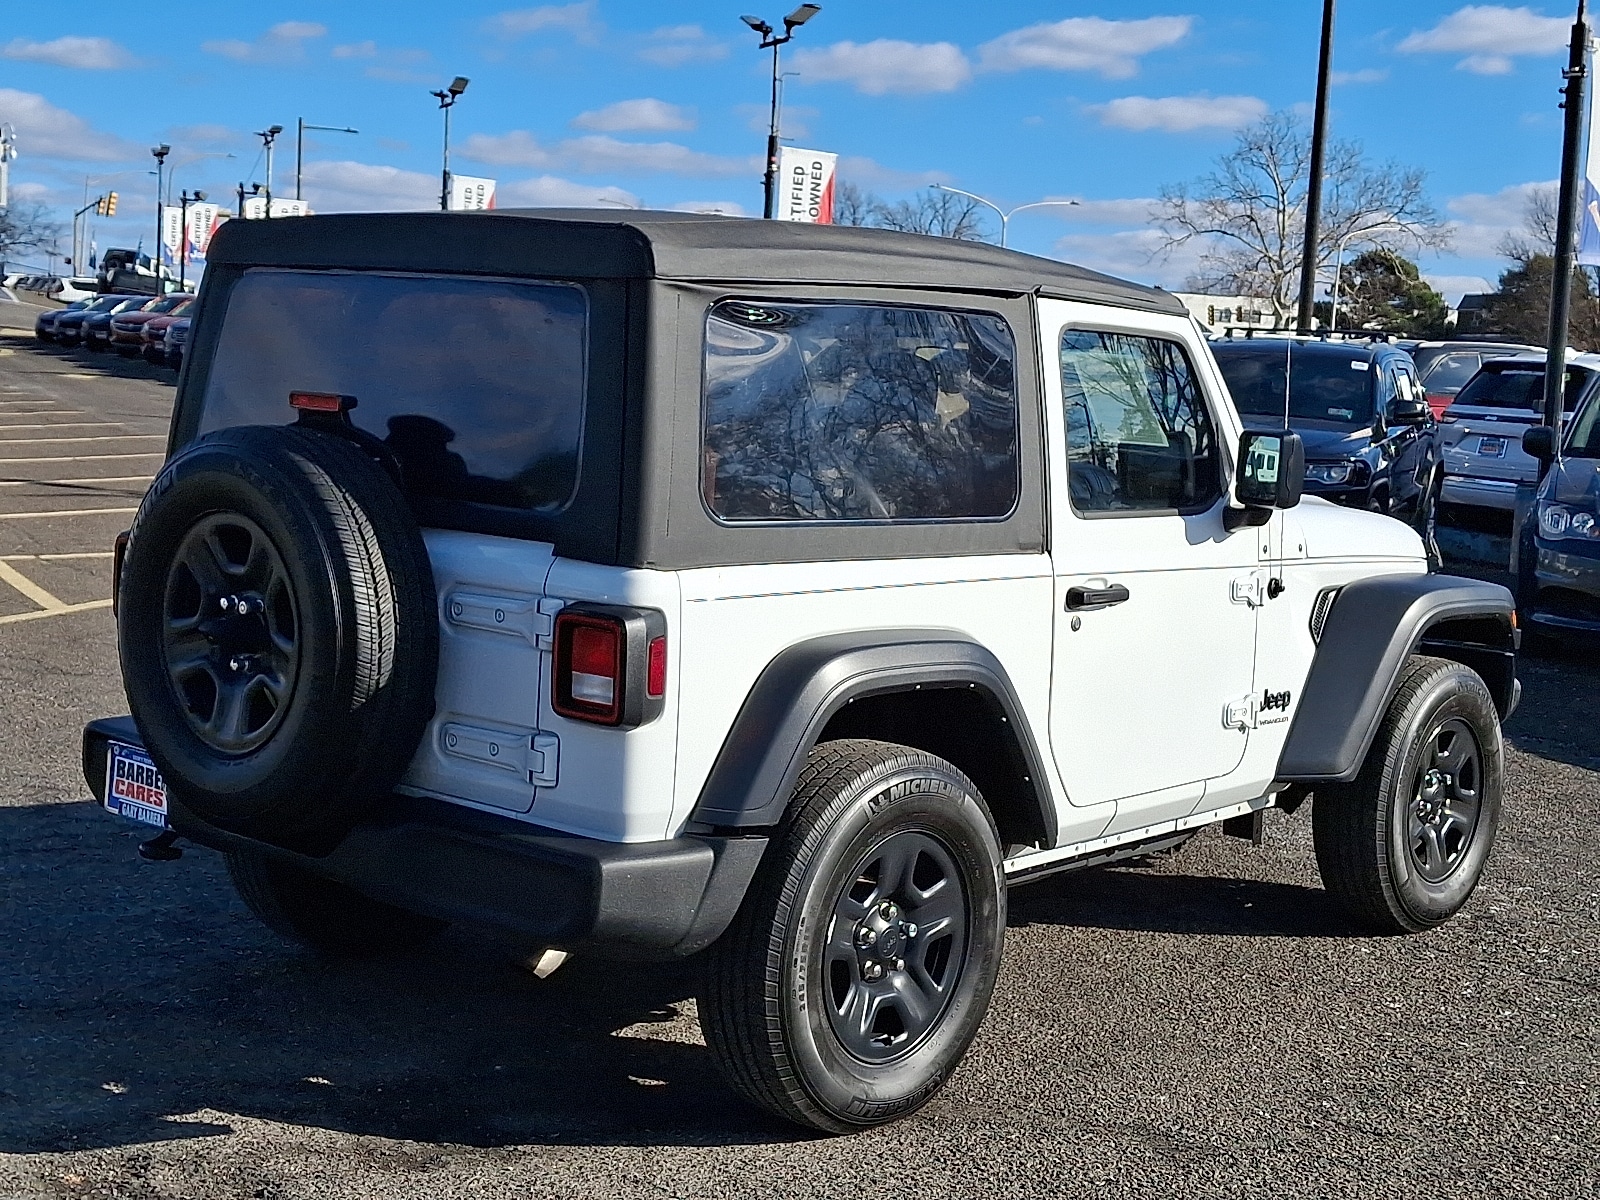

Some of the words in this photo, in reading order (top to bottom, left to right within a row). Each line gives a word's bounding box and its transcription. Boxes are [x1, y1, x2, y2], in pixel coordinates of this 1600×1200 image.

[1259, 689, 1291, 712] Jeep
[115, 779, 164, 808] CARES
[890, 779, 964, 806] MICHELIN
